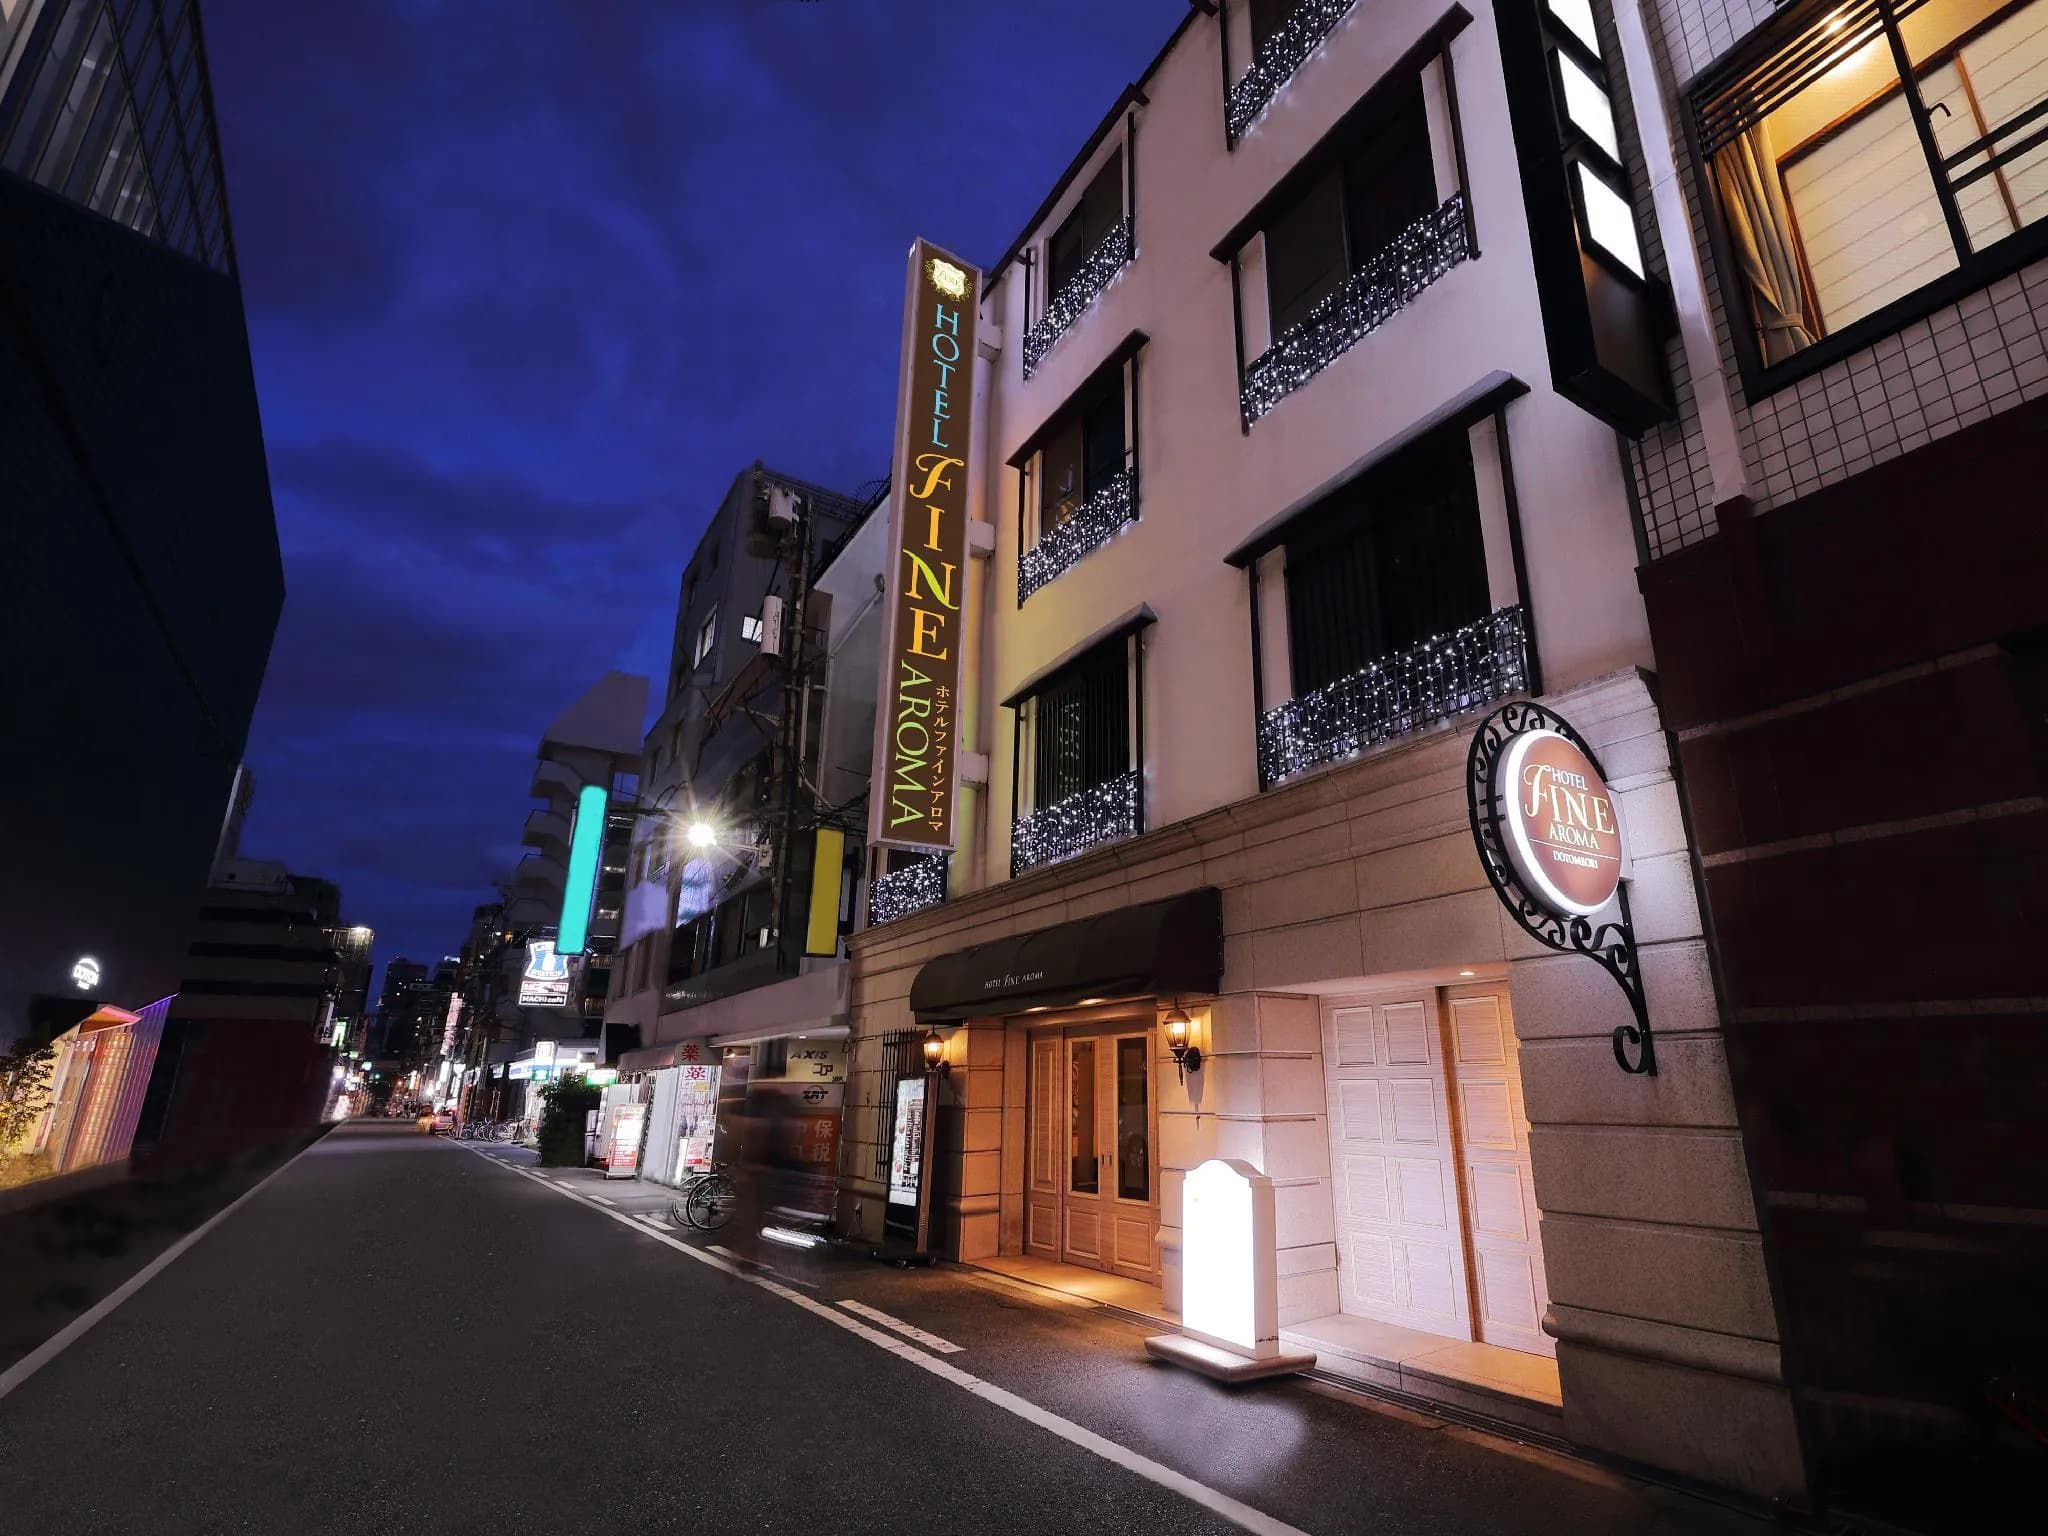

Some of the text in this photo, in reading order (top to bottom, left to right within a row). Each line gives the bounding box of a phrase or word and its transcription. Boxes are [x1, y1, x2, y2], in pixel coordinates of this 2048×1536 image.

[931, 303, 960, 448] HOTEL
[903, 453, 965, 660] FINE
[890, 659, 933, 829] AROMA
[928, 685, 950, 831] ホテルファインアロマ
[1551, 768, 1588, 791] HOTEL
[1523, 764, 1615, 835] FINE
[1549, 822, 1601, 850] AROMA
[681, 1043, 700, 1061] 薬
